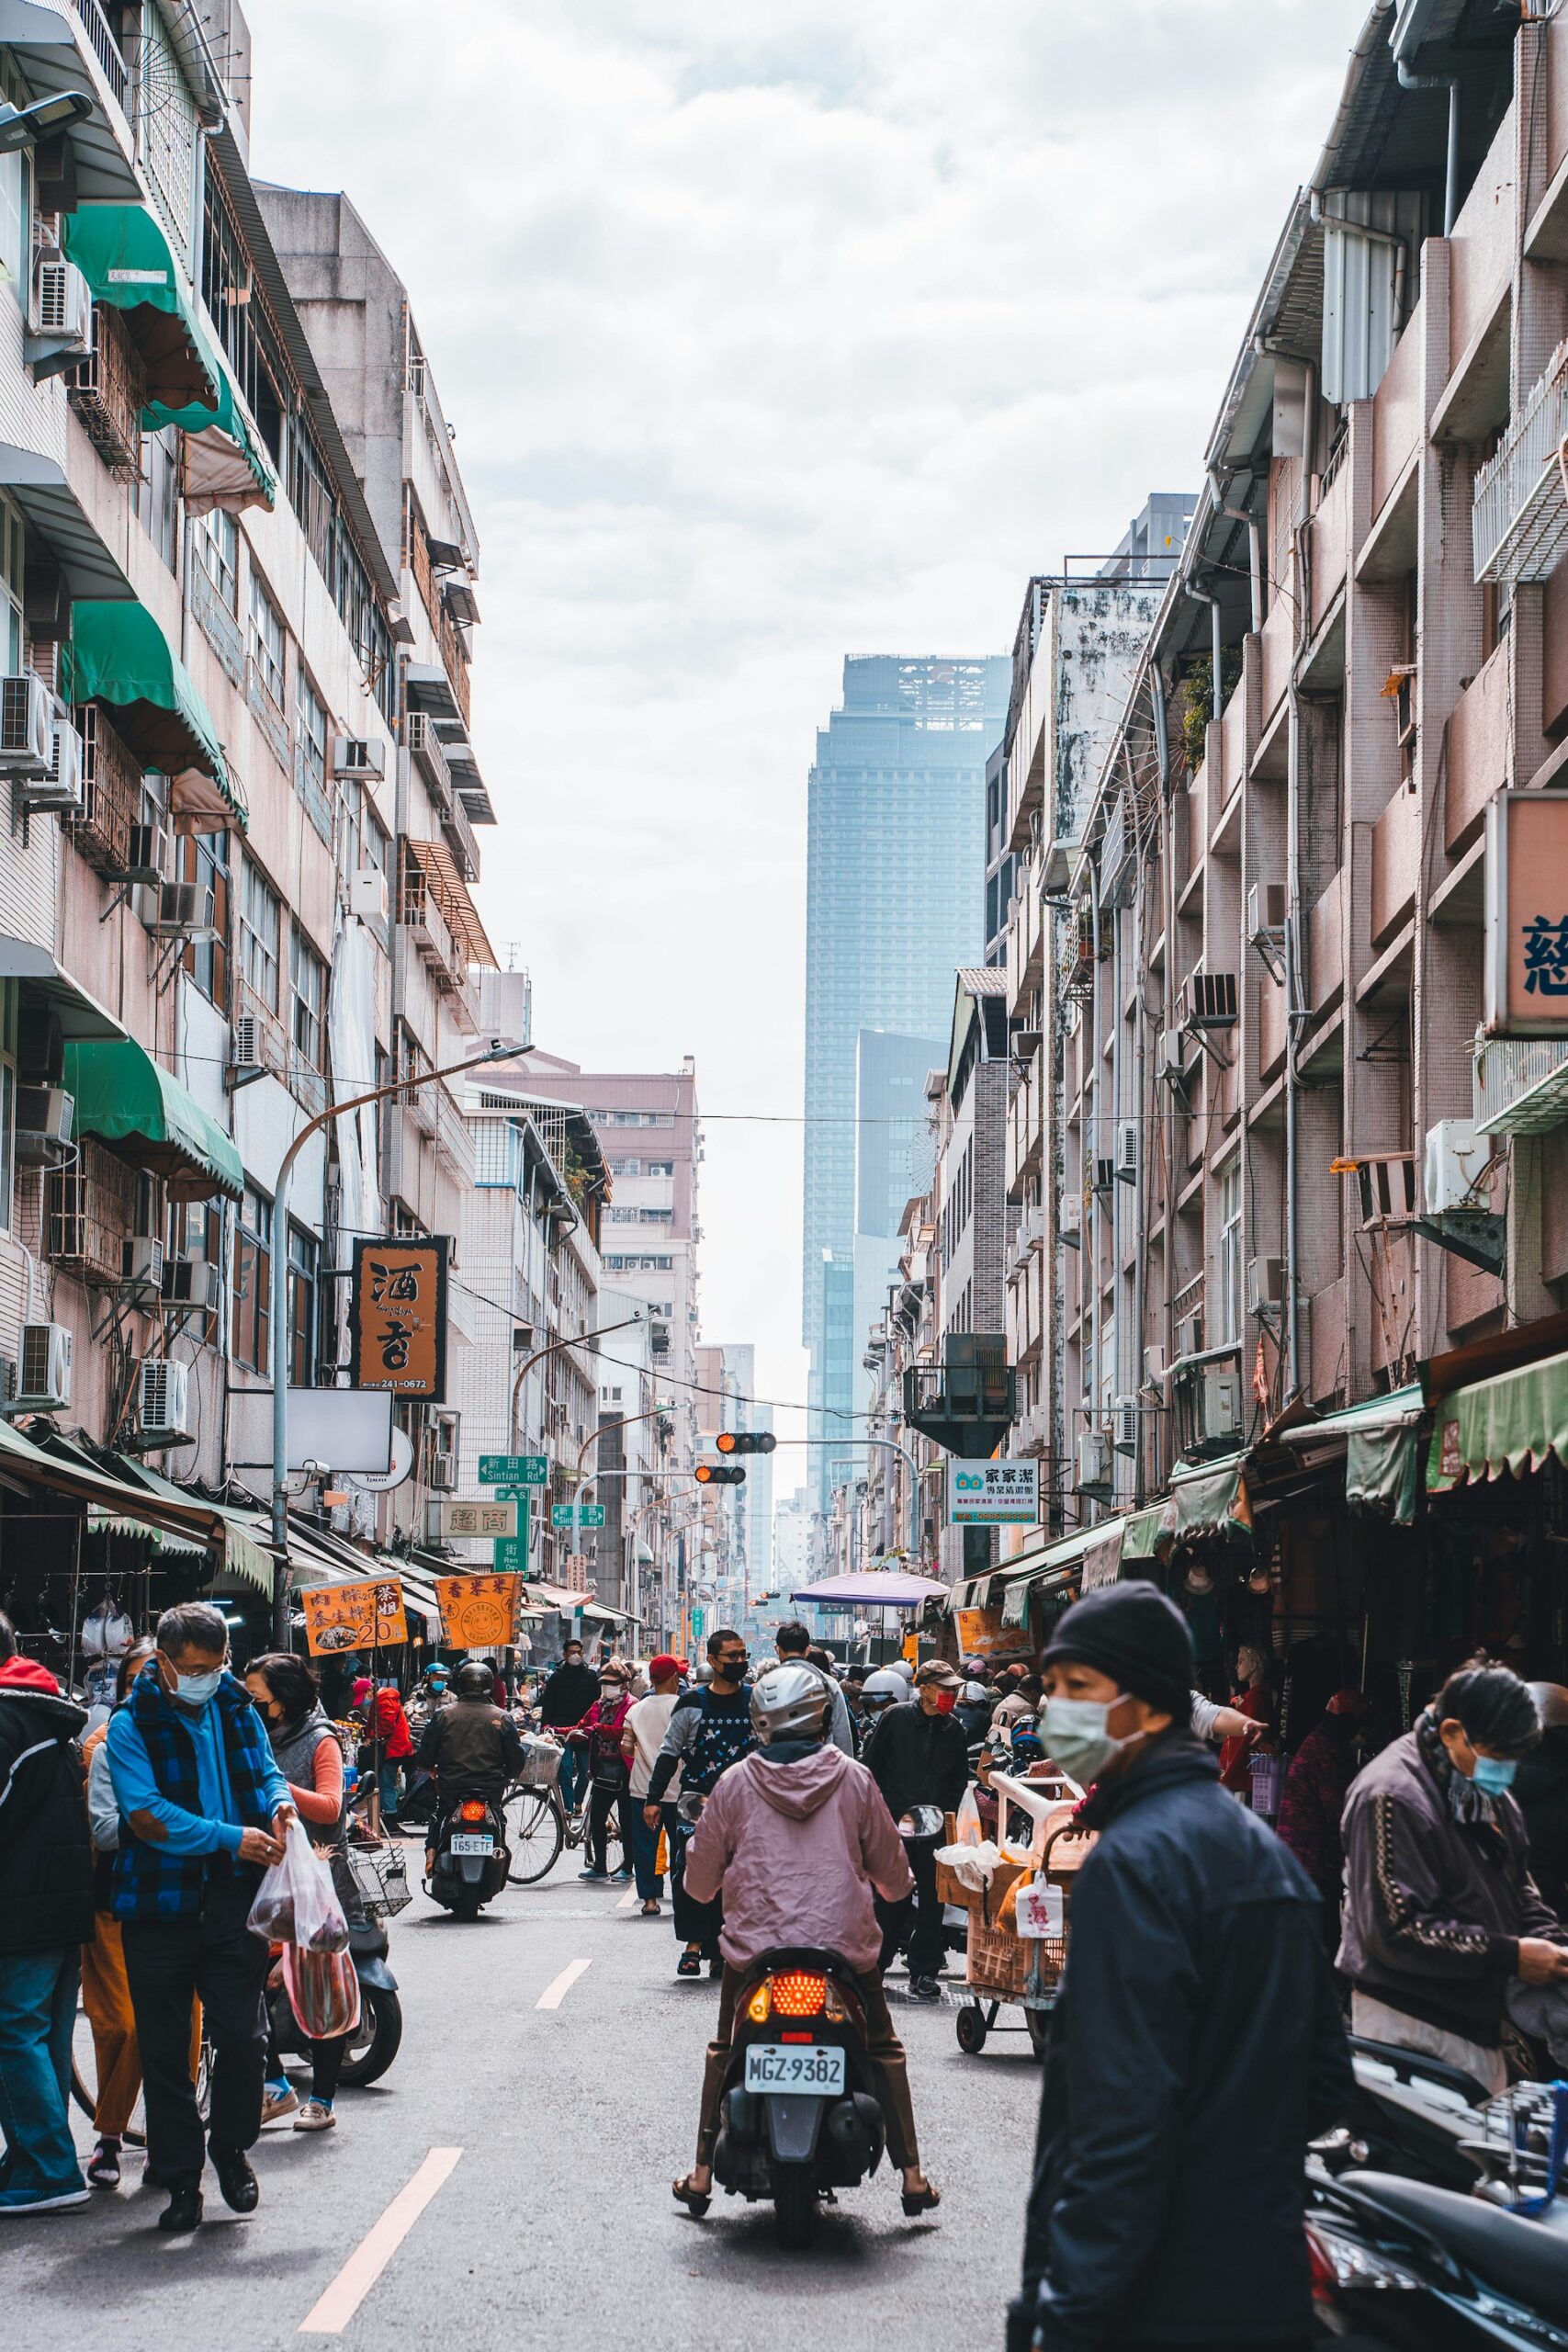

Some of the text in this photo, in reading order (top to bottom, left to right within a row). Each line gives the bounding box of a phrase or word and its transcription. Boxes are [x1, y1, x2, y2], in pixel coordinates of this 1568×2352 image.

[381, 1380, 426, 1388] 241-0672
[487, 1457, 538, 1470] 新田路
[487, 1471, 540, 1481] Sintian Rd.
[985, 1468, 1033, 1484] 家家潔
[450, 1510, 507, 1532] 超商
[505, 1544, 517, 1555] 街
[358, 1622, 391, 1643] 20
[454, 1840, 492, 1852] 165-ETF
[749, 2057, 840, 2083] MGZ-9382
